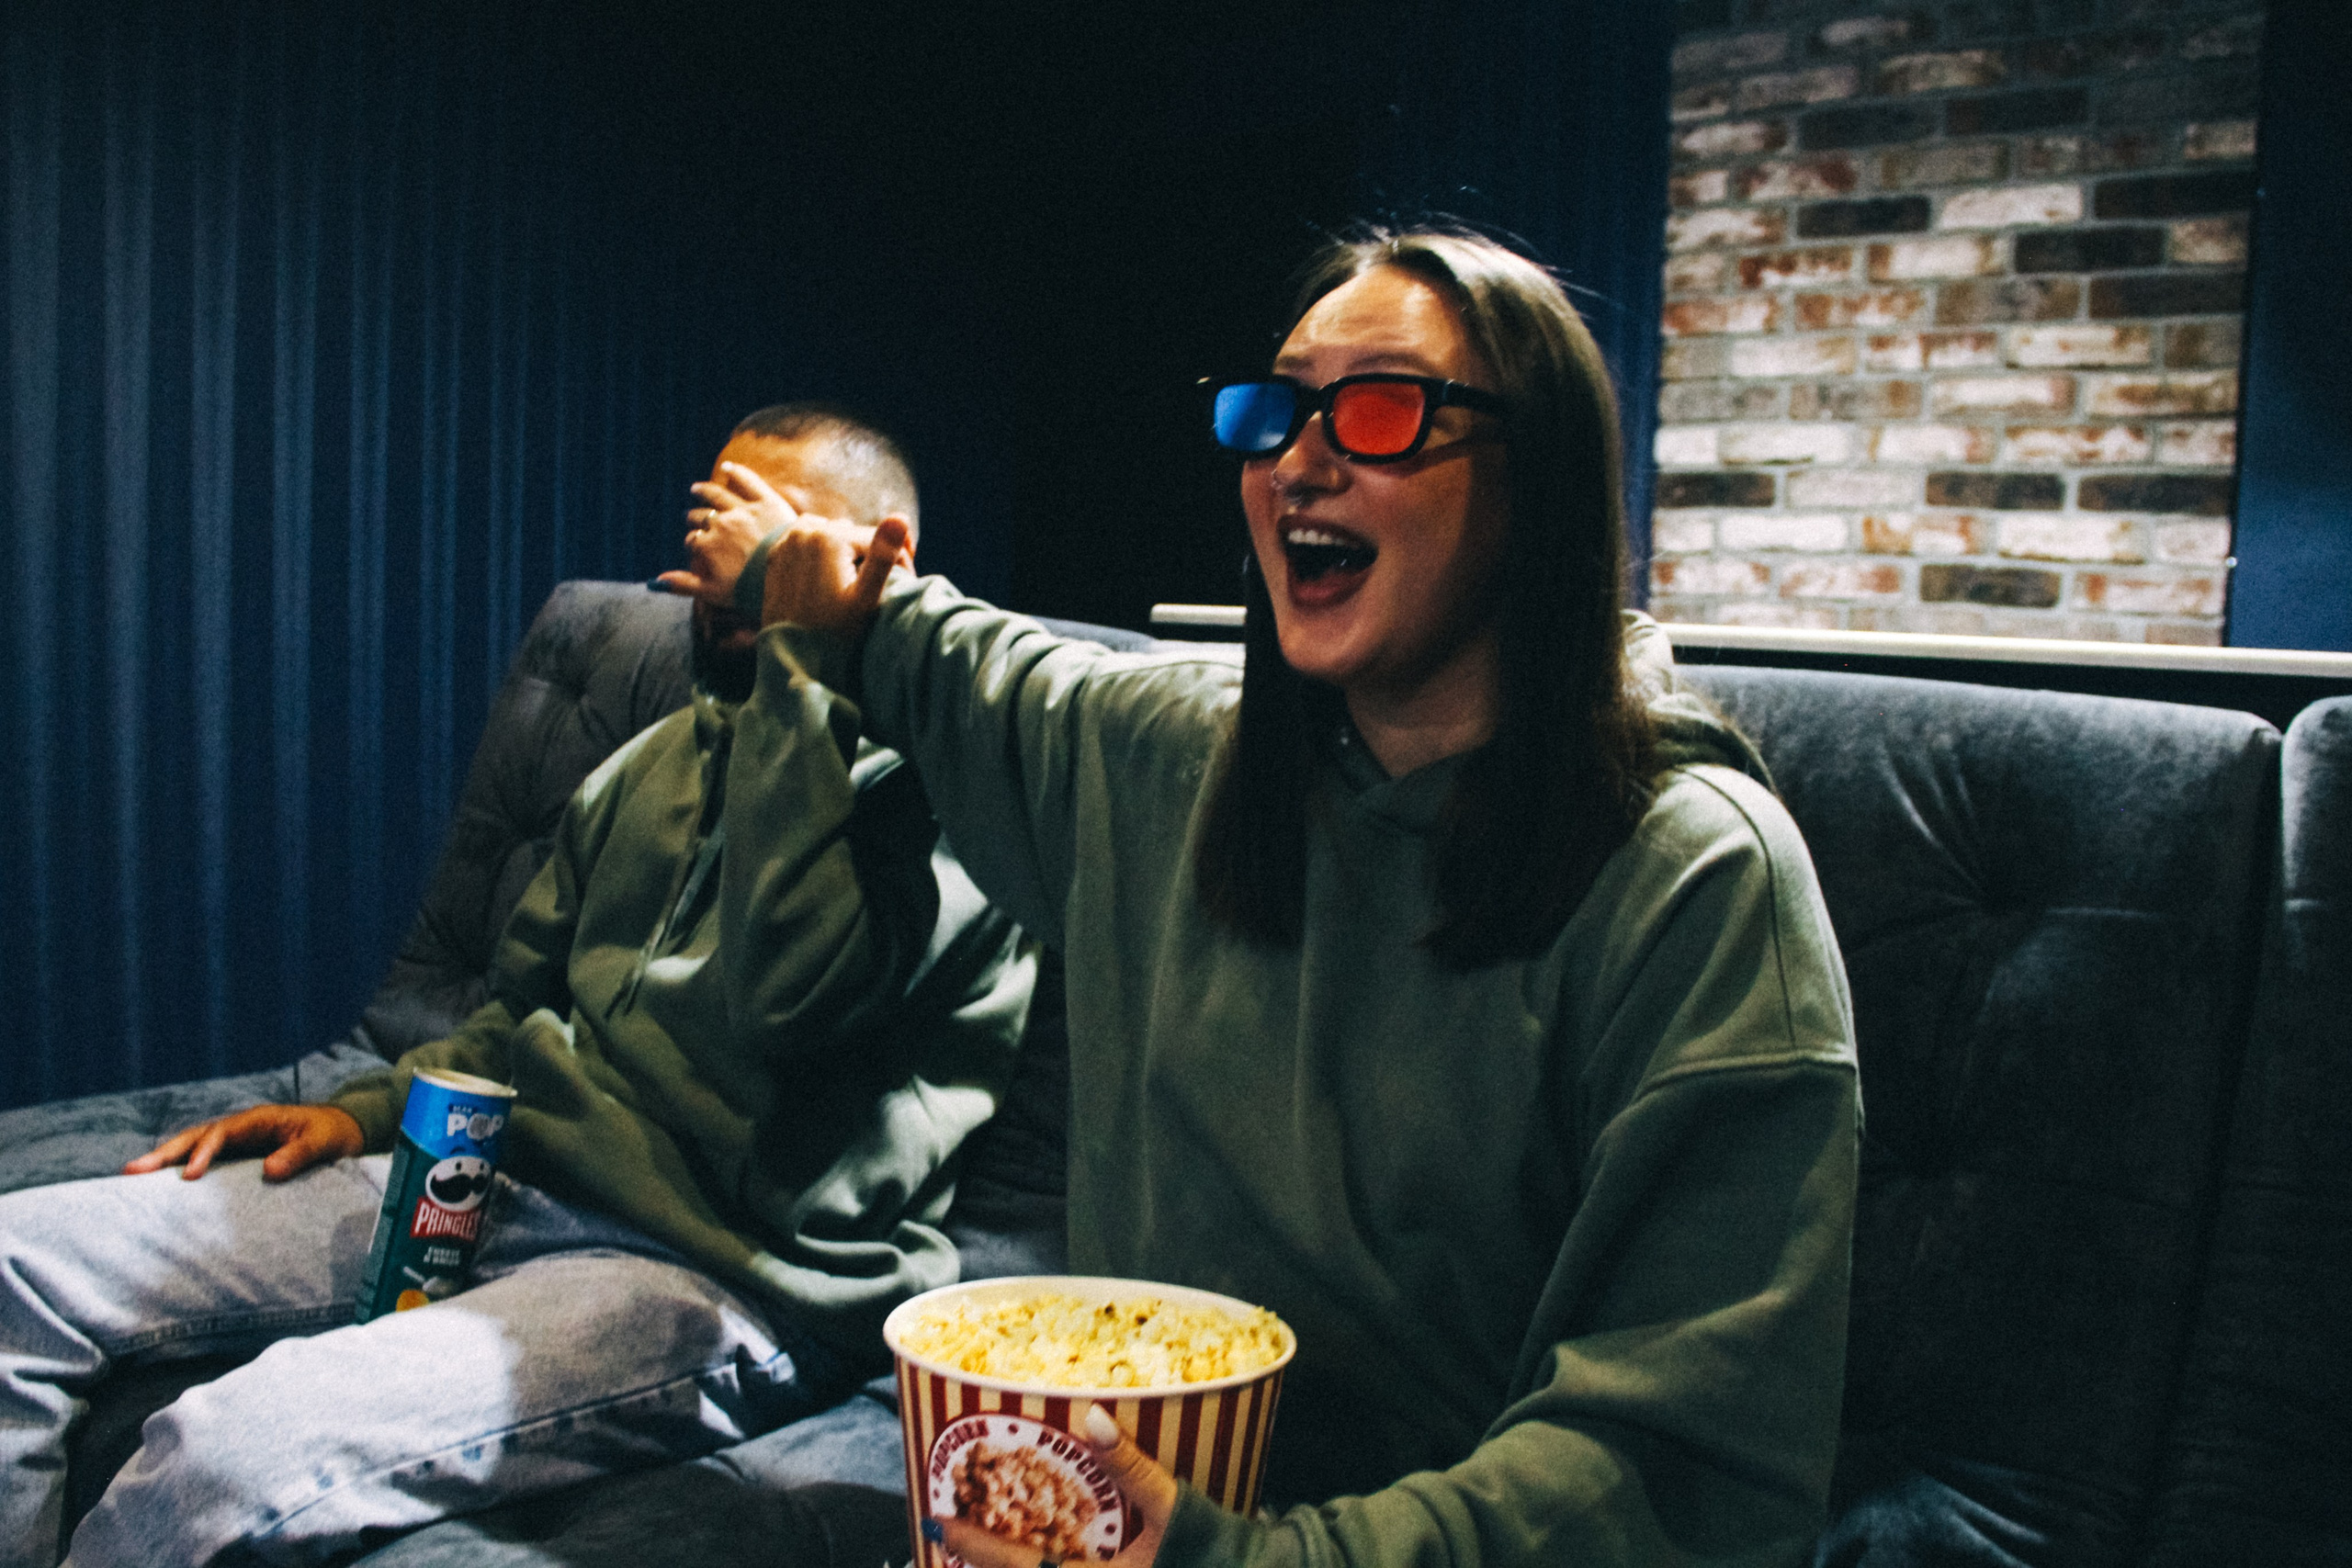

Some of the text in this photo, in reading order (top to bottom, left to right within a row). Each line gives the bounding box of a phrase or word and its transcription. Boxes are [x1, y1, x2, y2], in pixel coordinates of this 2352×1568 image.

[447, 1113, 503, 1139] POP
[414, 1201, 482, 1239] PRINGLES
[1036, 1429, 1118, 1513] POPCORN
